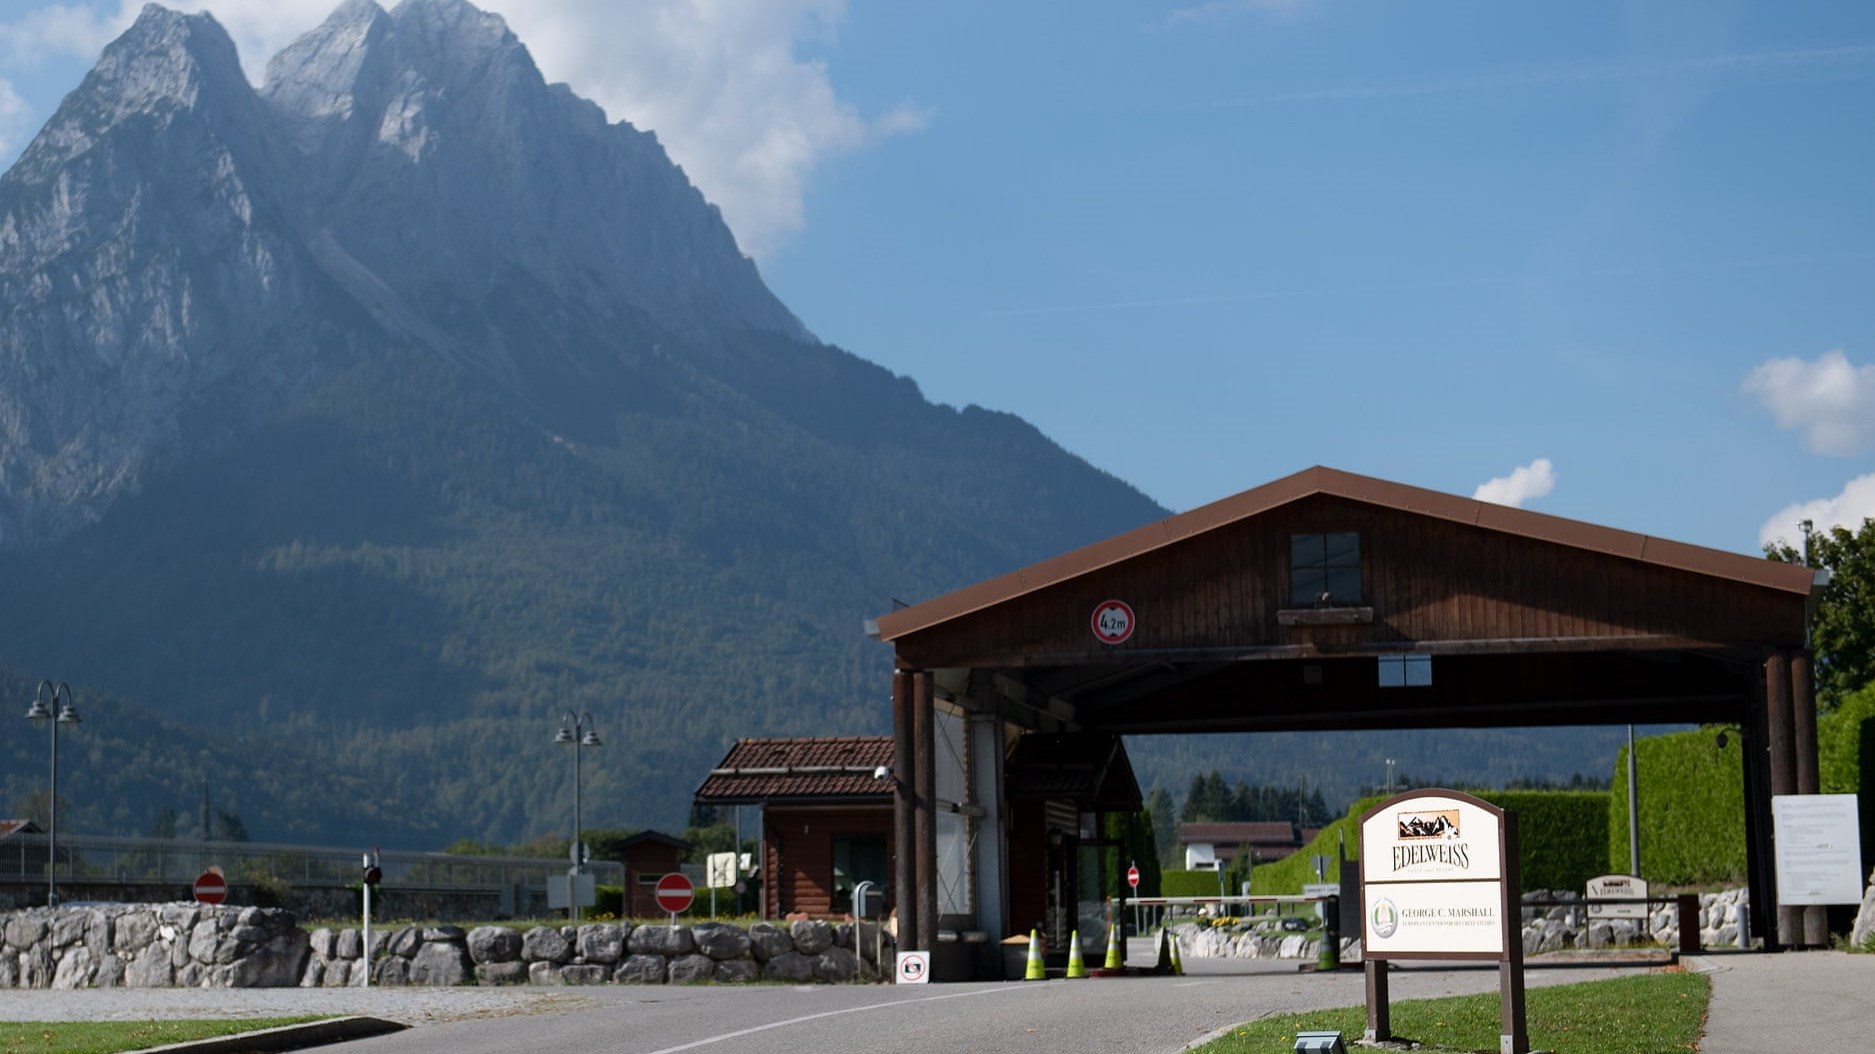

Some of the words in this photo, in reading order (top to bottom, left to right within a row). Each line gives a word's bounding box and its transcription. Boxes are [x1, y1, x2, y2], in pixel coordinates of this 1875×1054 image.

[1392, 843, 1469, 872] EDELWEISS
[1401, 908, 1436, 918] GEORGE
[1437, 908, 1446, 918] C.
[1447, 907, 1495, 917] MARSHALL
